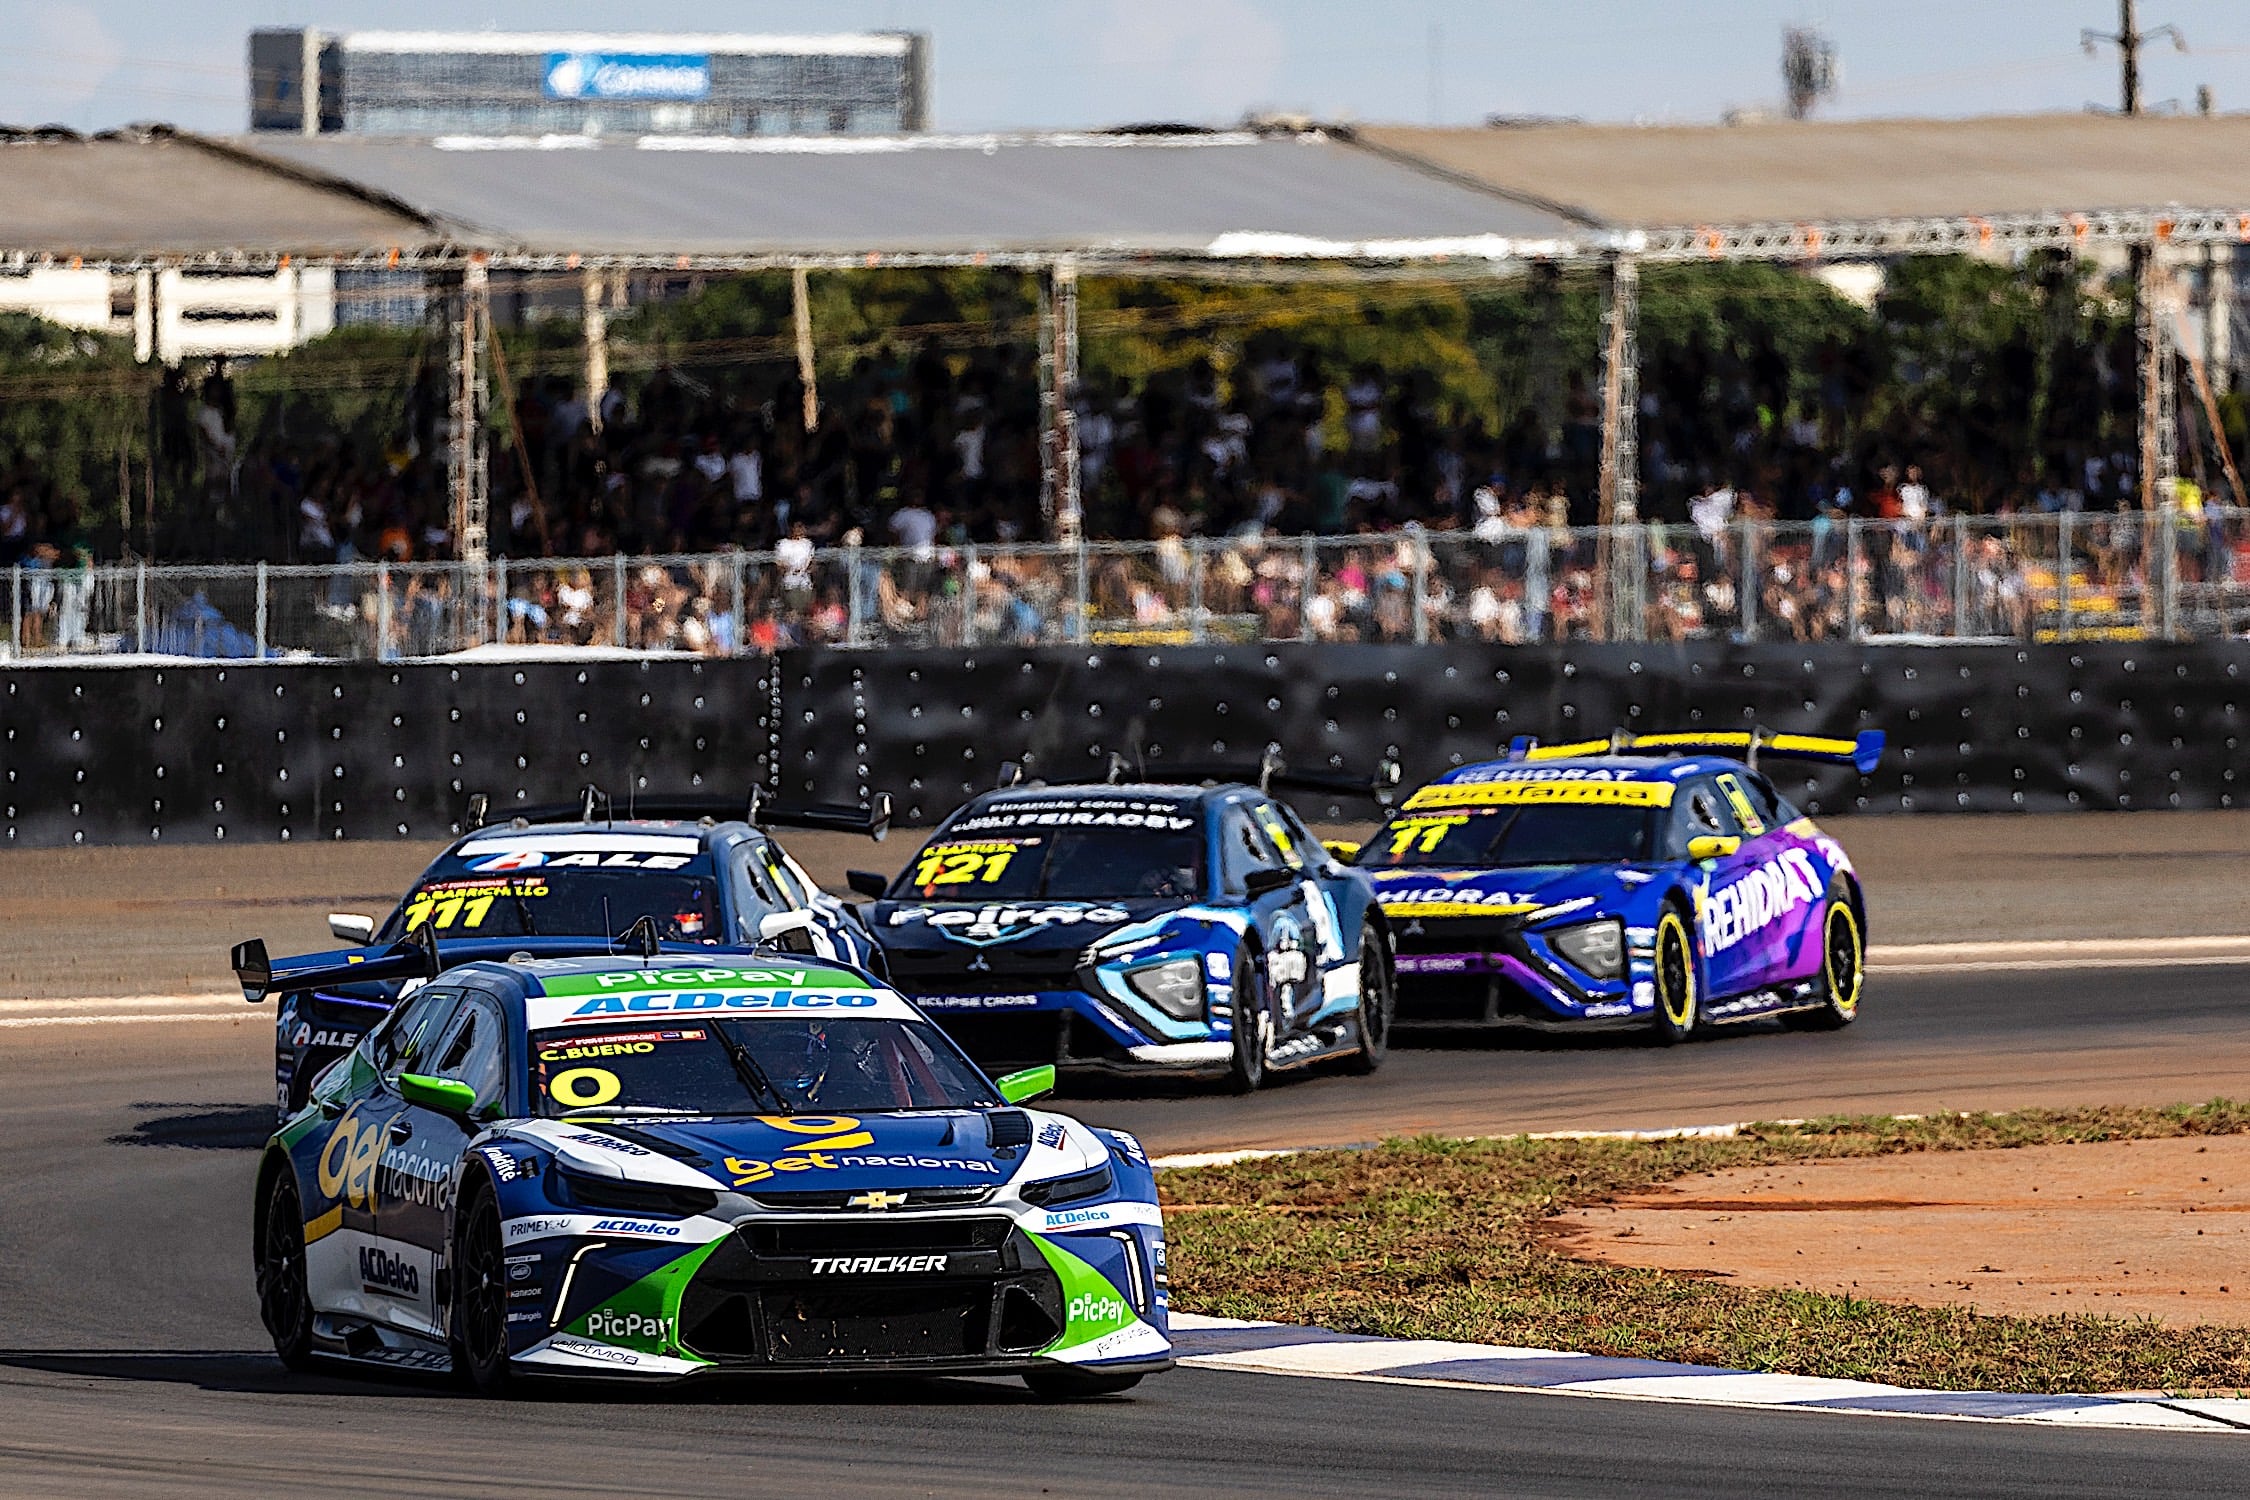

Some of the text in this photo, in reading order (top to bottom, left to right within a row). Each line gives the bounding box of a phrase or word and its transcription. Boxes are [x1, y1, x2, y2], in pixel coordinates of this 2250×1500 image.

[915, 852, 1013, 886] 121
[414, 886, 549, 902] R.BARRICHLLO
[1376, 888, 1536, 904] HIDRAT
[1701, 847, 1825, 957] REHIDRAT
[405, 896, 494, 933] 111
[595, 968, 807, 987] PicPay
[572, 990, 878, 1015] ACDelco
[917, 995, 1038, 1008] ECLIPSE CROSS
[311, 1030, 358, 1048] ALE
[539, 1042, 655, 1061] C.BUENO
[318, 1098, 403, 1215] bet
[567, 1133, 651, 1157] ACDelco
[723, 1153, 1000, 1178] bet nacional
[592, 1219, 681, 1237] ACDelco
[1046, 1211, 1110, 1226] ACDelco
[360, 1246, 419, 1295] ACDelco
[810, 1254, 948, 1275] TRACKER
[1068, 1293, 1125, 1325] PicPay
[588, 1308, 674, 1342] PicPay
